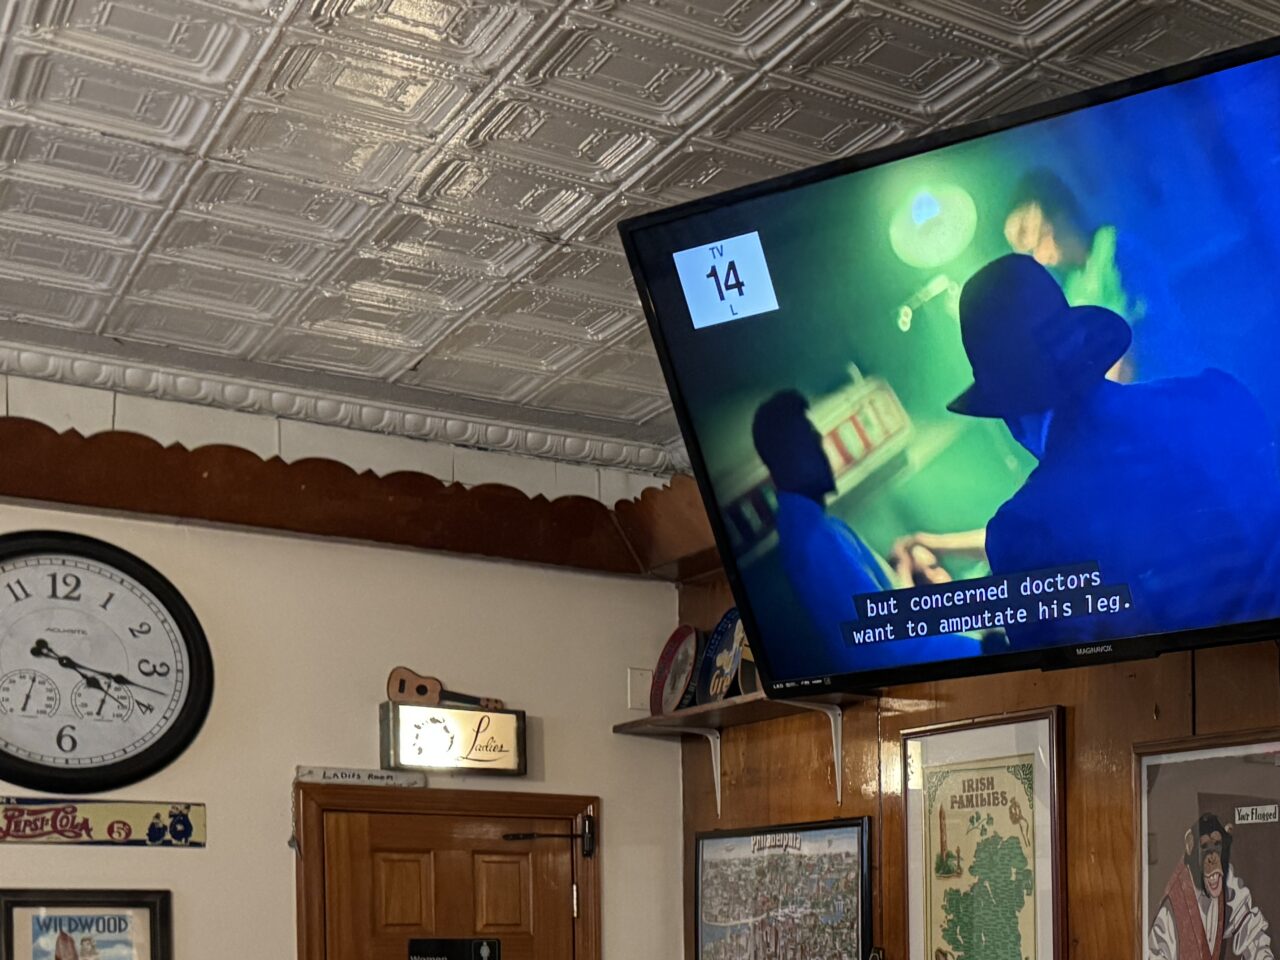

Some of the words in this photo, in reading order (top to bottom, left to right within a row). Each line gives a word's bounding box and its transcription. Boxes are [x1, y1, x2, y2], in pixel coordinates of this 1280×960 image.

[709, 245, 724, 259] TV
[706, 260, 745, 302] 14
[730, 304, 738, 316] L
[5, 579, 32, 602] 11
[47, 572, 81, 600] 12
[867, 597, 899, 618] but
[910, 580, 1008, 612] concerned
[1020, 570, 1101, 597] doctors
[100, 592, 115, 611] 1
[853, 623, 895, 644] want
[906, 620, 928, 637] to
[939, 606, 1028, 633] amputate
[1038, 600, 1073, 620] his
[1085, 594, 1131, 613] leg.
[128, 622, 152, 638] 2
[1076, 645, 1113, 656] MAGNAVOX
[138, 658, 171, 677] 3
[135, 699, 154, 715] 4
[56, 725, 77, 753] 6
[453, 715, 510, 762] Ladies
[962, 776, 994, 793] IRISH
[950, 791, 1008, 809] FAMILIES
[751, 832, 801, 854] Philadelphia
[36, 916, 128, 933] WILDWOOD
